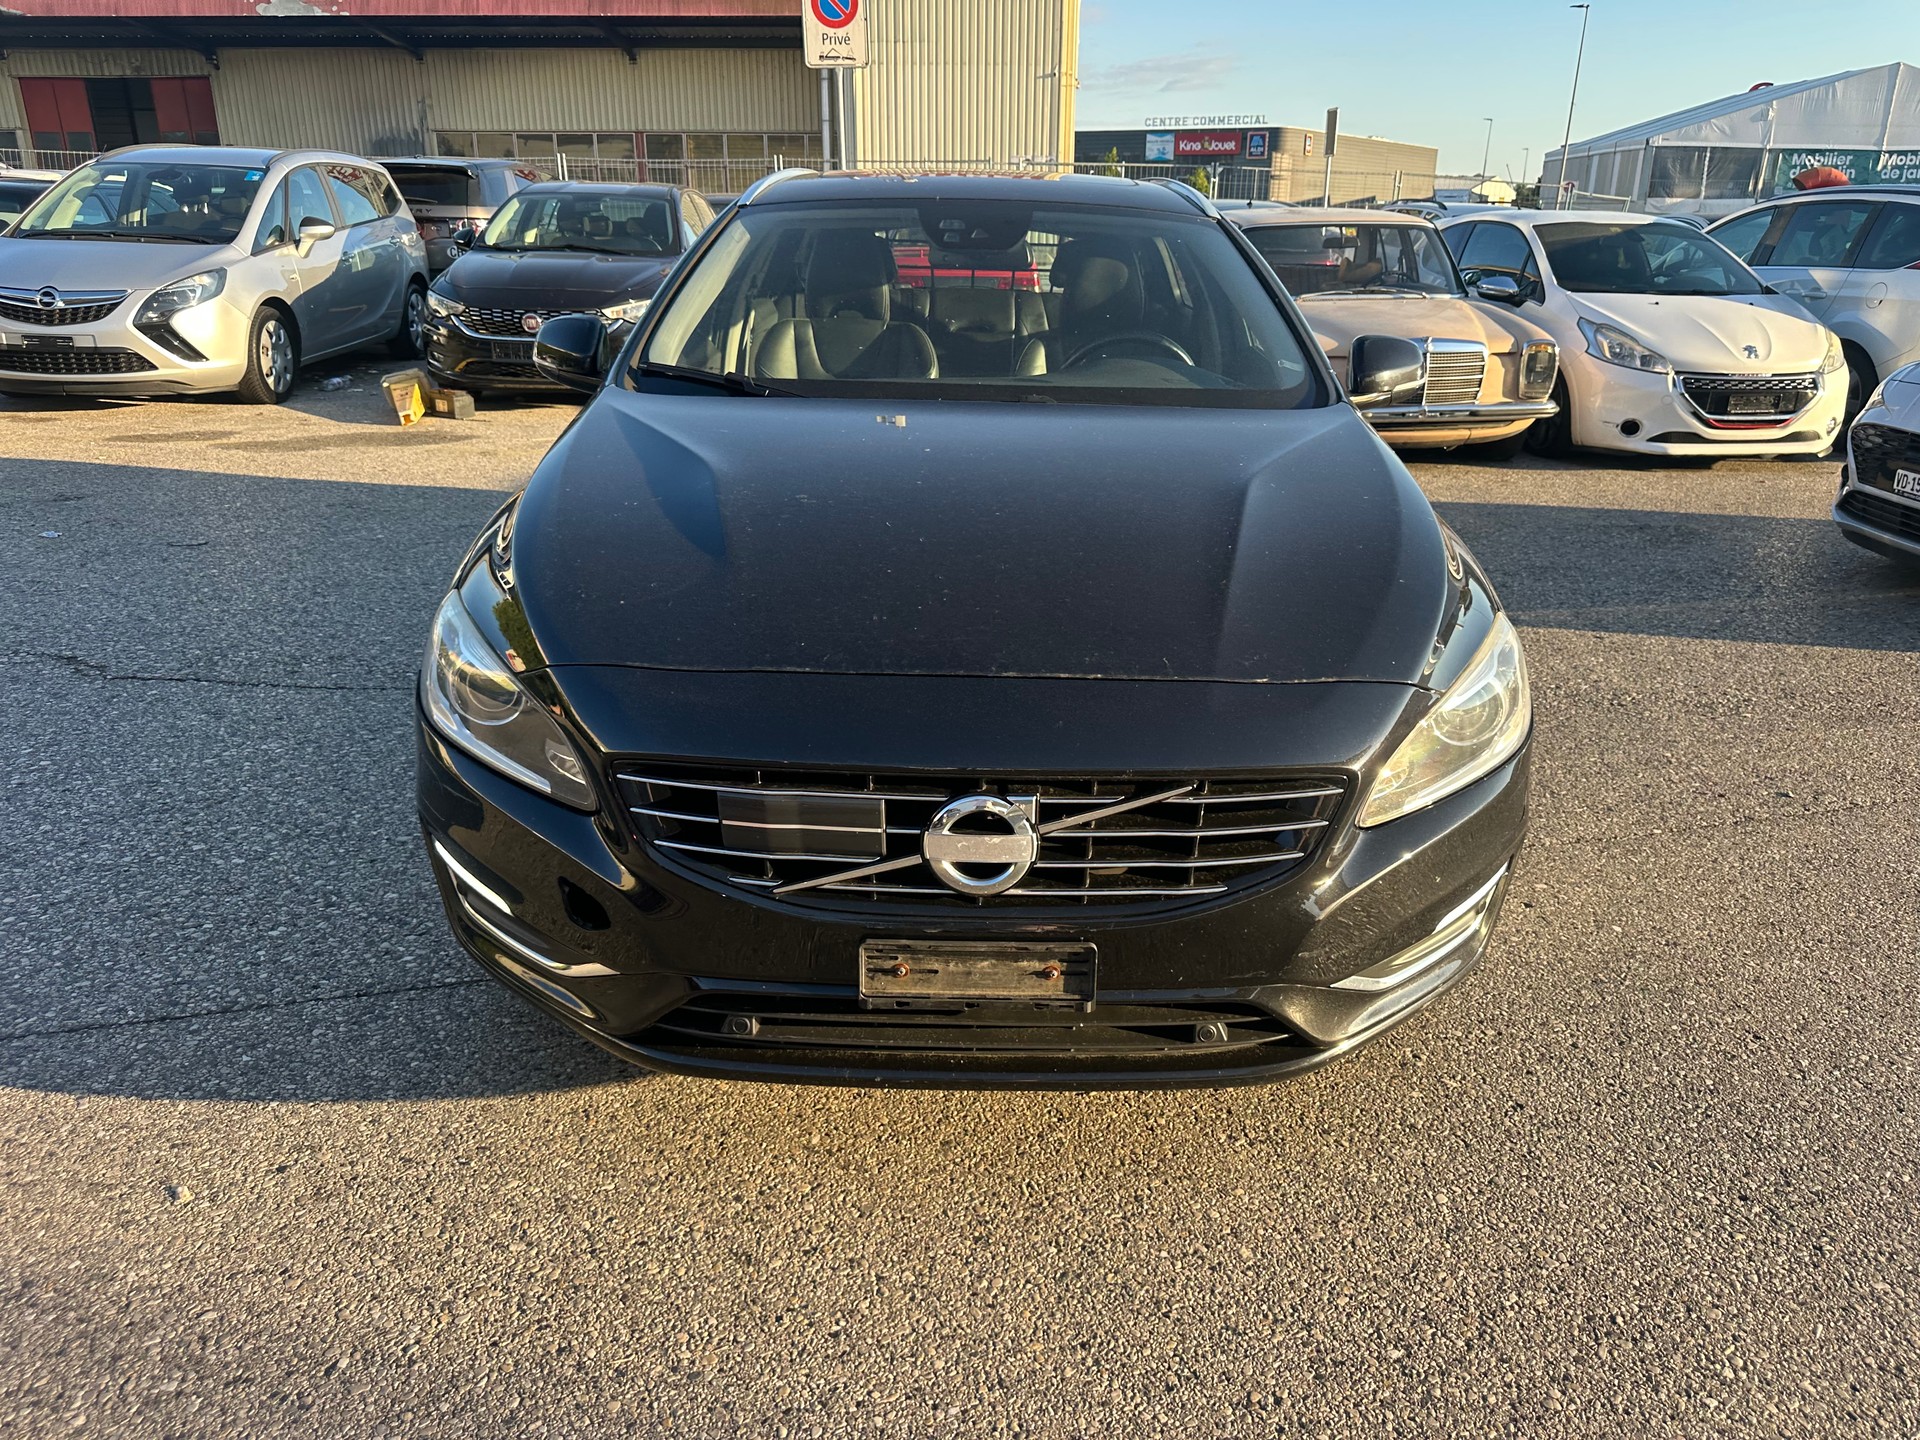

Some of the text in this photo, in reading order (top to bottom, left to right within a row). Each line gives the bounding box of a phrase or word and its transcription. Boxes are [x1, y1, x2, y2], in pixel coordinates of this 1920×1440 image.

[822, 32, 850, 45] Privé
[1144, 114, 1268, 127] CENTRE COMMERCIAL
[1179, 140, 1201, 151] King
[1208, 140, 1236, 150] Jouet
[1791, 152, 1853, 165] Mobilier
[1881, 165, 1900, 178] de
